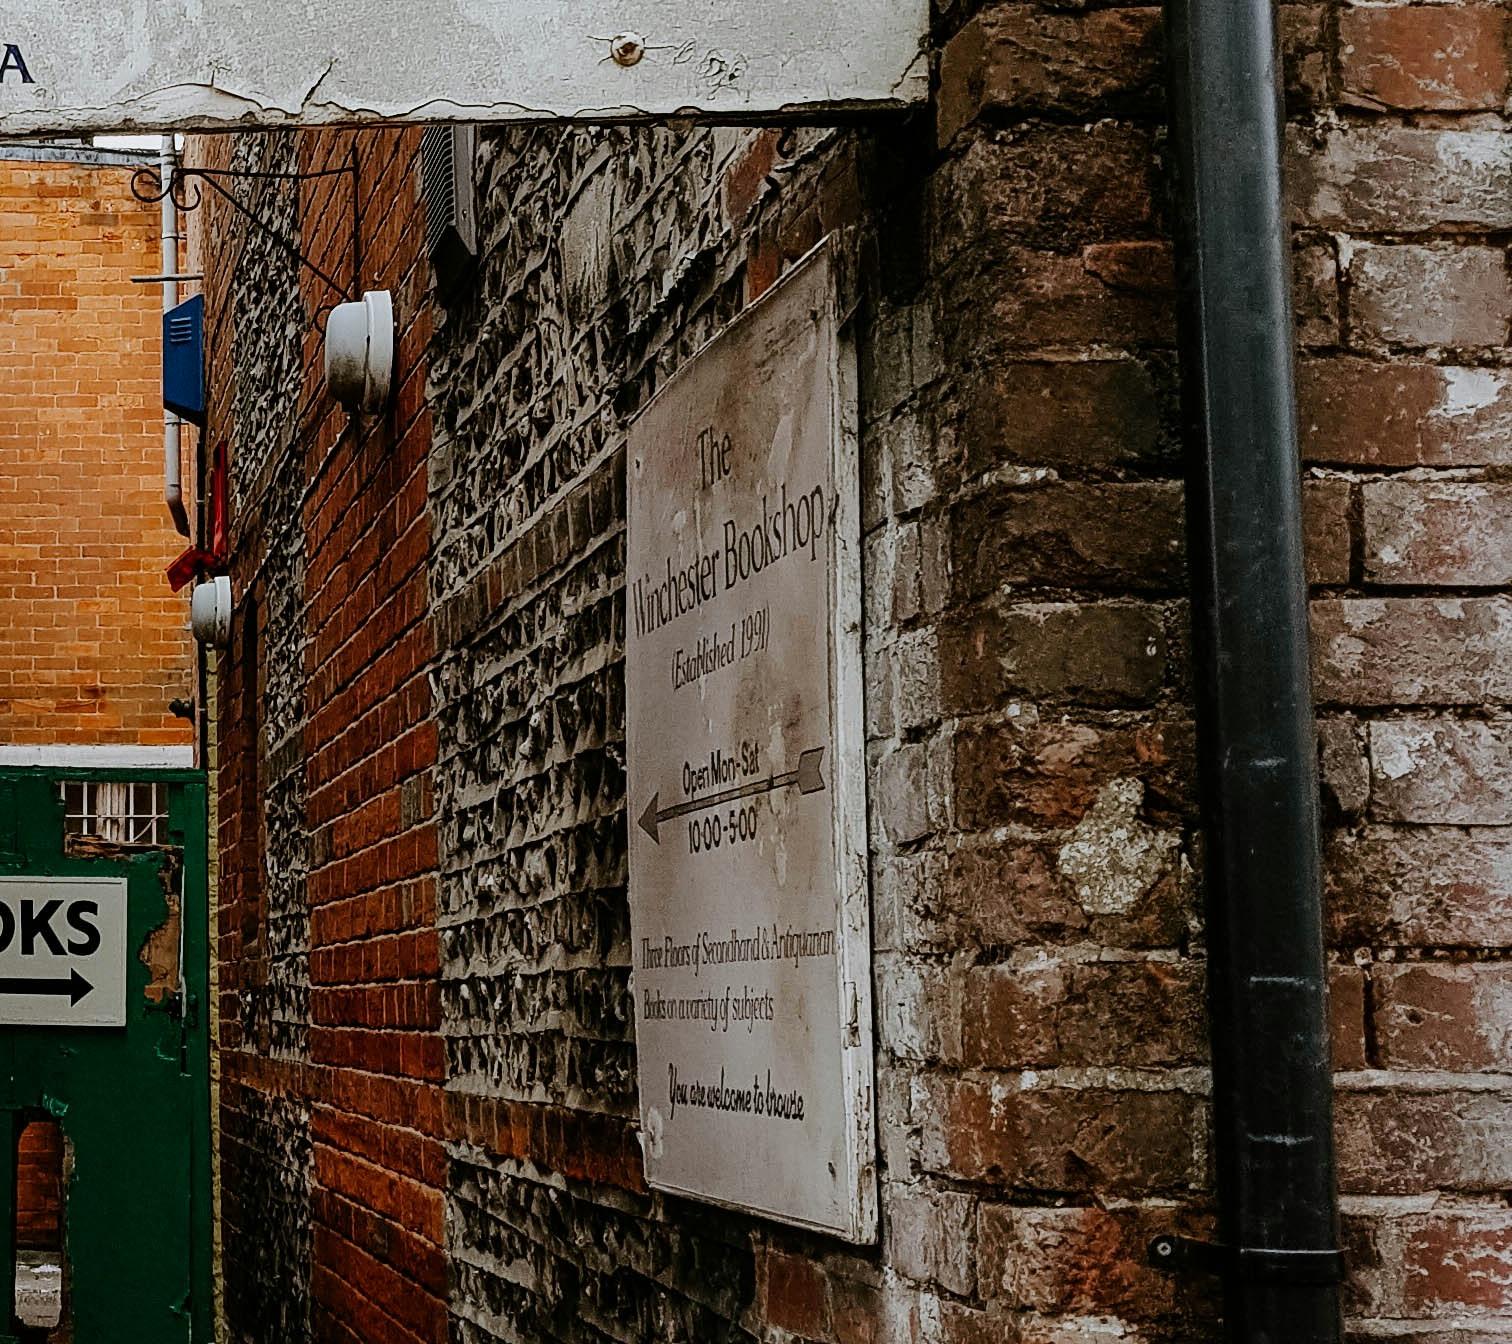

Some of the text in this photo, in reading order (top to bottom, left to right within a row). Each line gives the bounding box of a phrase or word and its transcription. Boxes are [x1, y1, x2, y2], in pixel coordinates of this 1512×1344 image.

[698, 425, 732, 490] The
[633, 483, 824, 640] Winchester Bookshop
[672, 624, 735, 691] (Established
[683, 761, 710, 798] Open
[642, 923, 835, 977] Three Floors of Secondhand & Antiquarian
[644, 989, 666, 1019] Books
[667, 999, 676, 1019] on
[686, 989, 717, 1031] variety
[720, 986, 730, 1032] of
[732, 985, 774, 1034] subjects
[668, 1063, 804, 1120] You are welcome to browse
